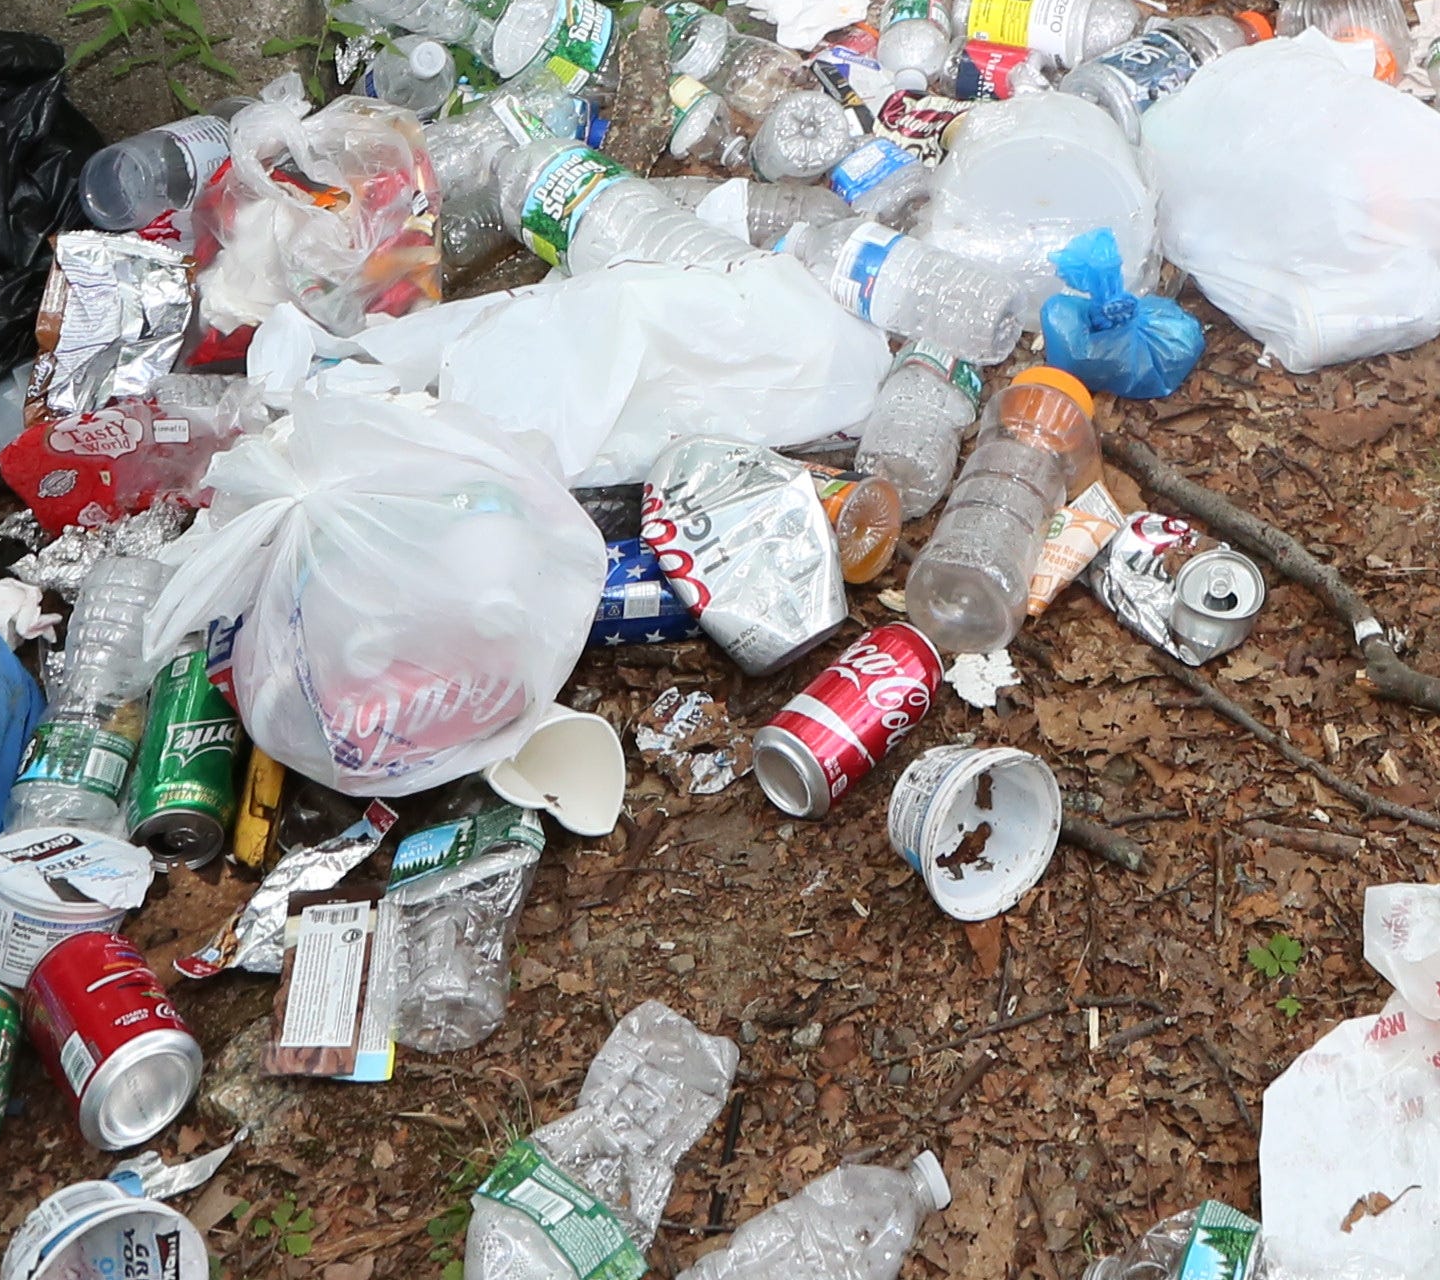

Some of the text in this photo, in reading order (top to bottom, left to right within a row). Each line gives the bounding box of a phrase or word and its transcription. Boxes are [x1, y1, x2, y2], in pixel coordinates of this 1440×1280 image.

[1050, 0, 1070, 34] zero
[534, 154, 583, 203] Poland
[542, 159, 608, 222] Spring
[82, 438, 131, 454] World
